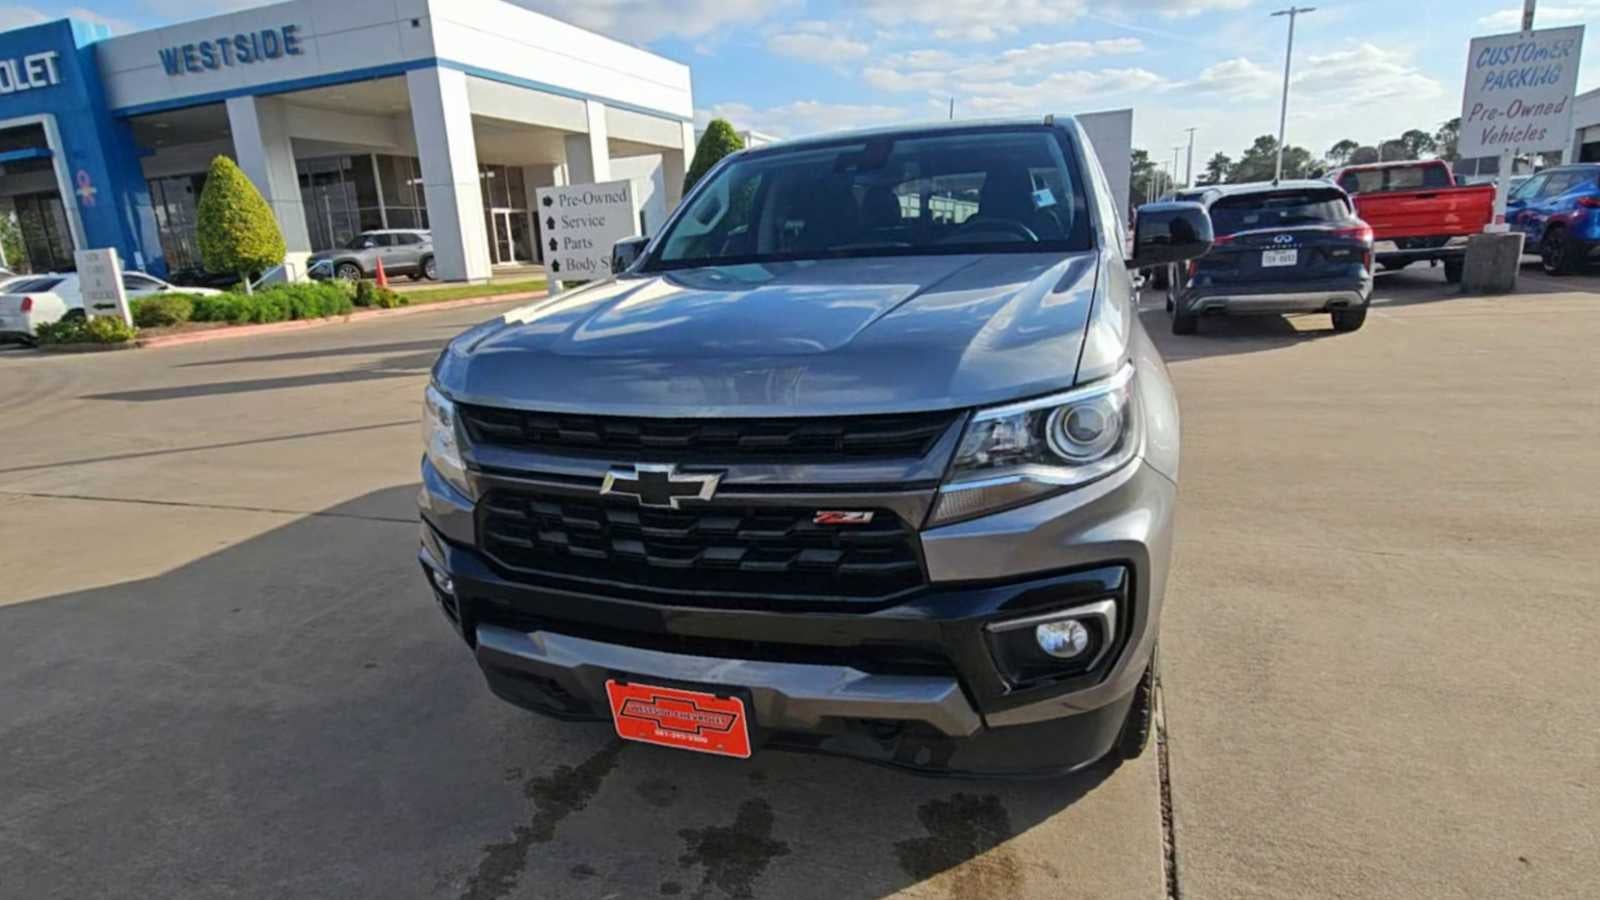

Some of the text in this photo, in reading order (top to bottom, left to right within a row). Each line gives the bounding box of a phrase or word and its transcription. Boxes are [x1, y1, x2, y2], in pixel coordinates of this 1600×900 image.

[159, 24, 304, 76] WESTSIDE
[1481, 66, 1562, 92] PARKING
[1468, 96, 1568, 123] Pre-Owned
[1480, 123, 1547, 146] Vehicles
[558, 188, 627, 208] Pre-Owned
[561, 215, 606, 230] Service
[563, 237, 593, 250] Parts
[566, 257, 597, 273] Body
